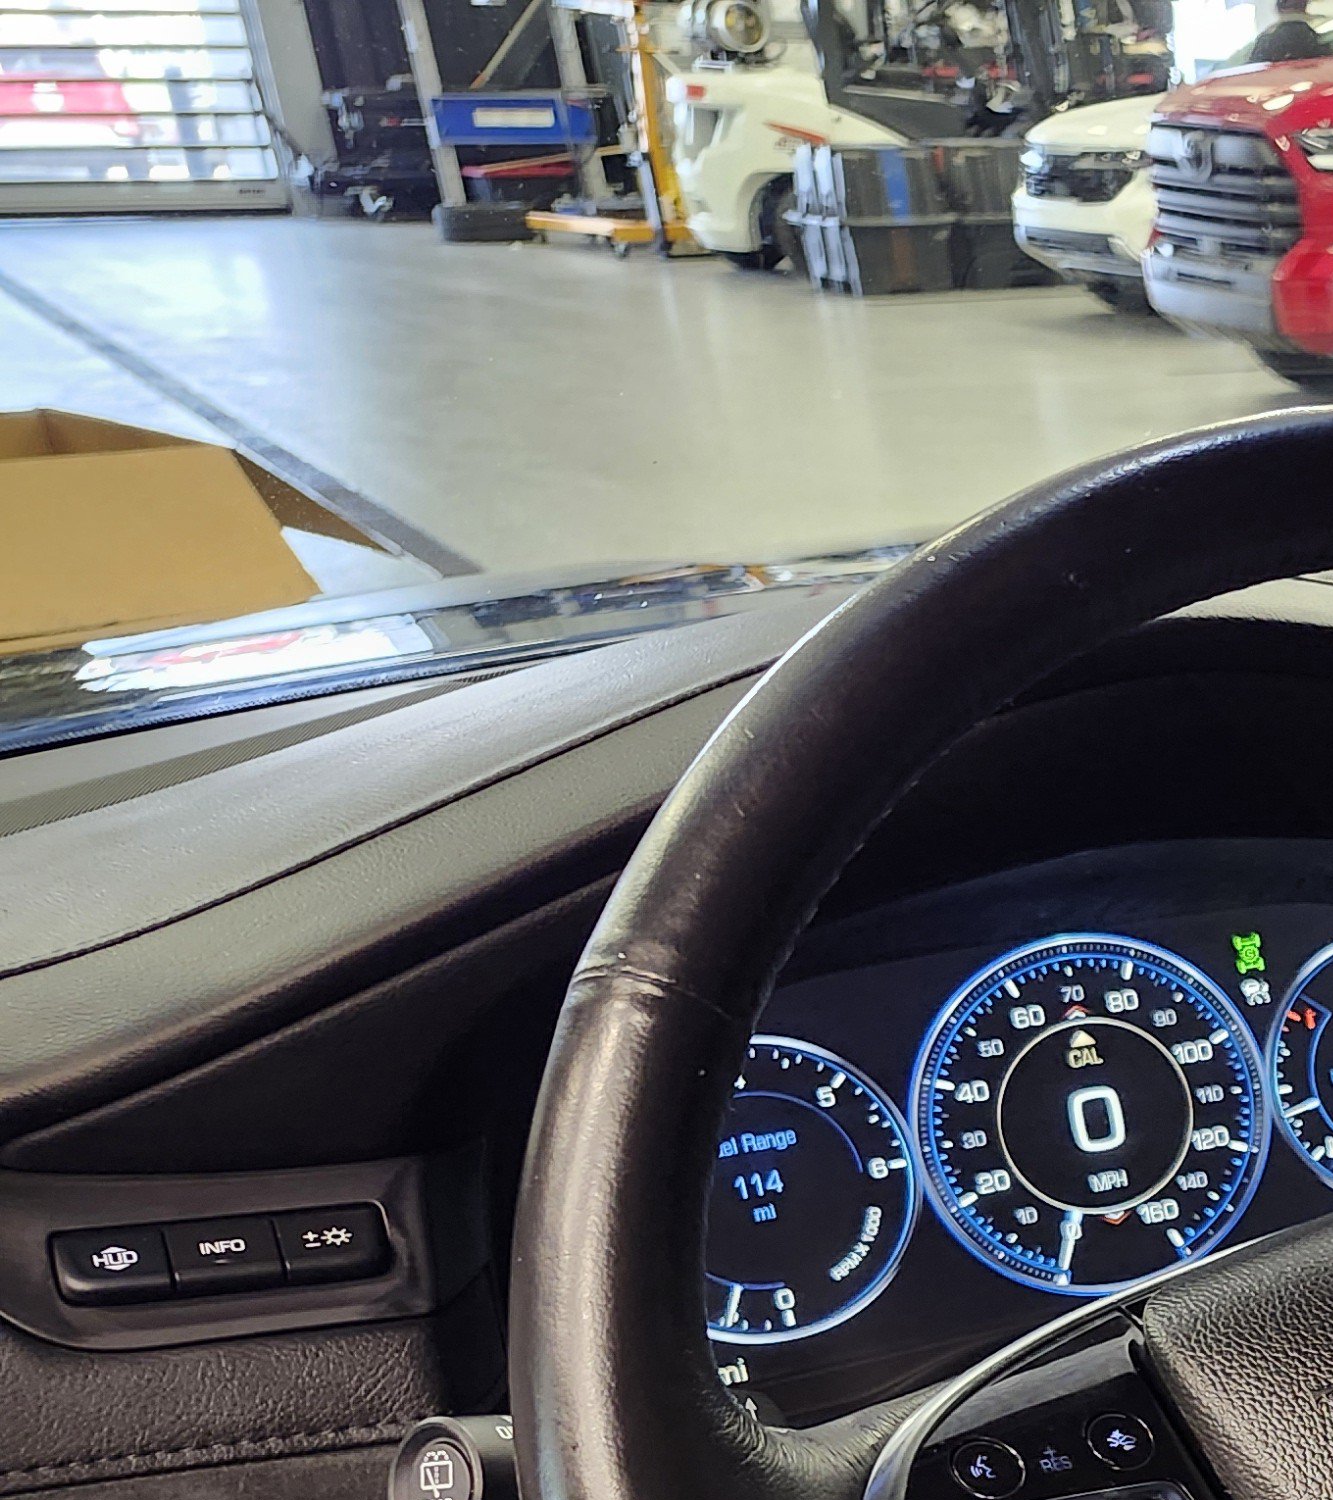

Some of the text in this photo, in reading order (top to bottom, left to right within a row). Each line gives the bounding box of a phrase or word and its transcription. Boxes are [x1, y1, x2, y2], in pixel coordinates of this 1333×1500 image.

[1060, 984, 1086, 1003] 70
[1104, 988, 1139, 1013] 80
[1010, 1004, 1046, 1029] 60
[1152, 1008, 1177, 1027] 90
[977, 1038, 1004, 1057] 50
[1067, 1049, 1104, 1069] CAL
[1171, 1038, 1213, 1065] 100
[815, 1085, 836, 1108] 5
[955, 1079, 990, 1104] 40
[1195, 1084, 1225, 1104] 110
[1066, 1084, 1126, 1153] 0
[741, 1128, 797, 1155] Range
[961, 1130, 988, 1150] 30
[1191, 1125, 1230, 1151] 120
[867, 1156, 890, 1180] 6
[734, 1168, 785, 1200] 114
[975, 1169, 1011, 1195] 20
[1087, 1168, 1129, 1193] MPH
[1175, 1171, 1209, 1191] 140
[752, 1203, 778, 1222] mi
[1013, 1206, 1039, 1225] 10
[1136, 1199, 1180, 1225] 160
[91, 1247, 138, 1270] HUD
[199, 1238, 246, 1256] INFO
[828, 1250, 864, 1281] RPM
[774, 1287, 797, 1311] 0
[1039, 1455, 1073, 1472] RES
